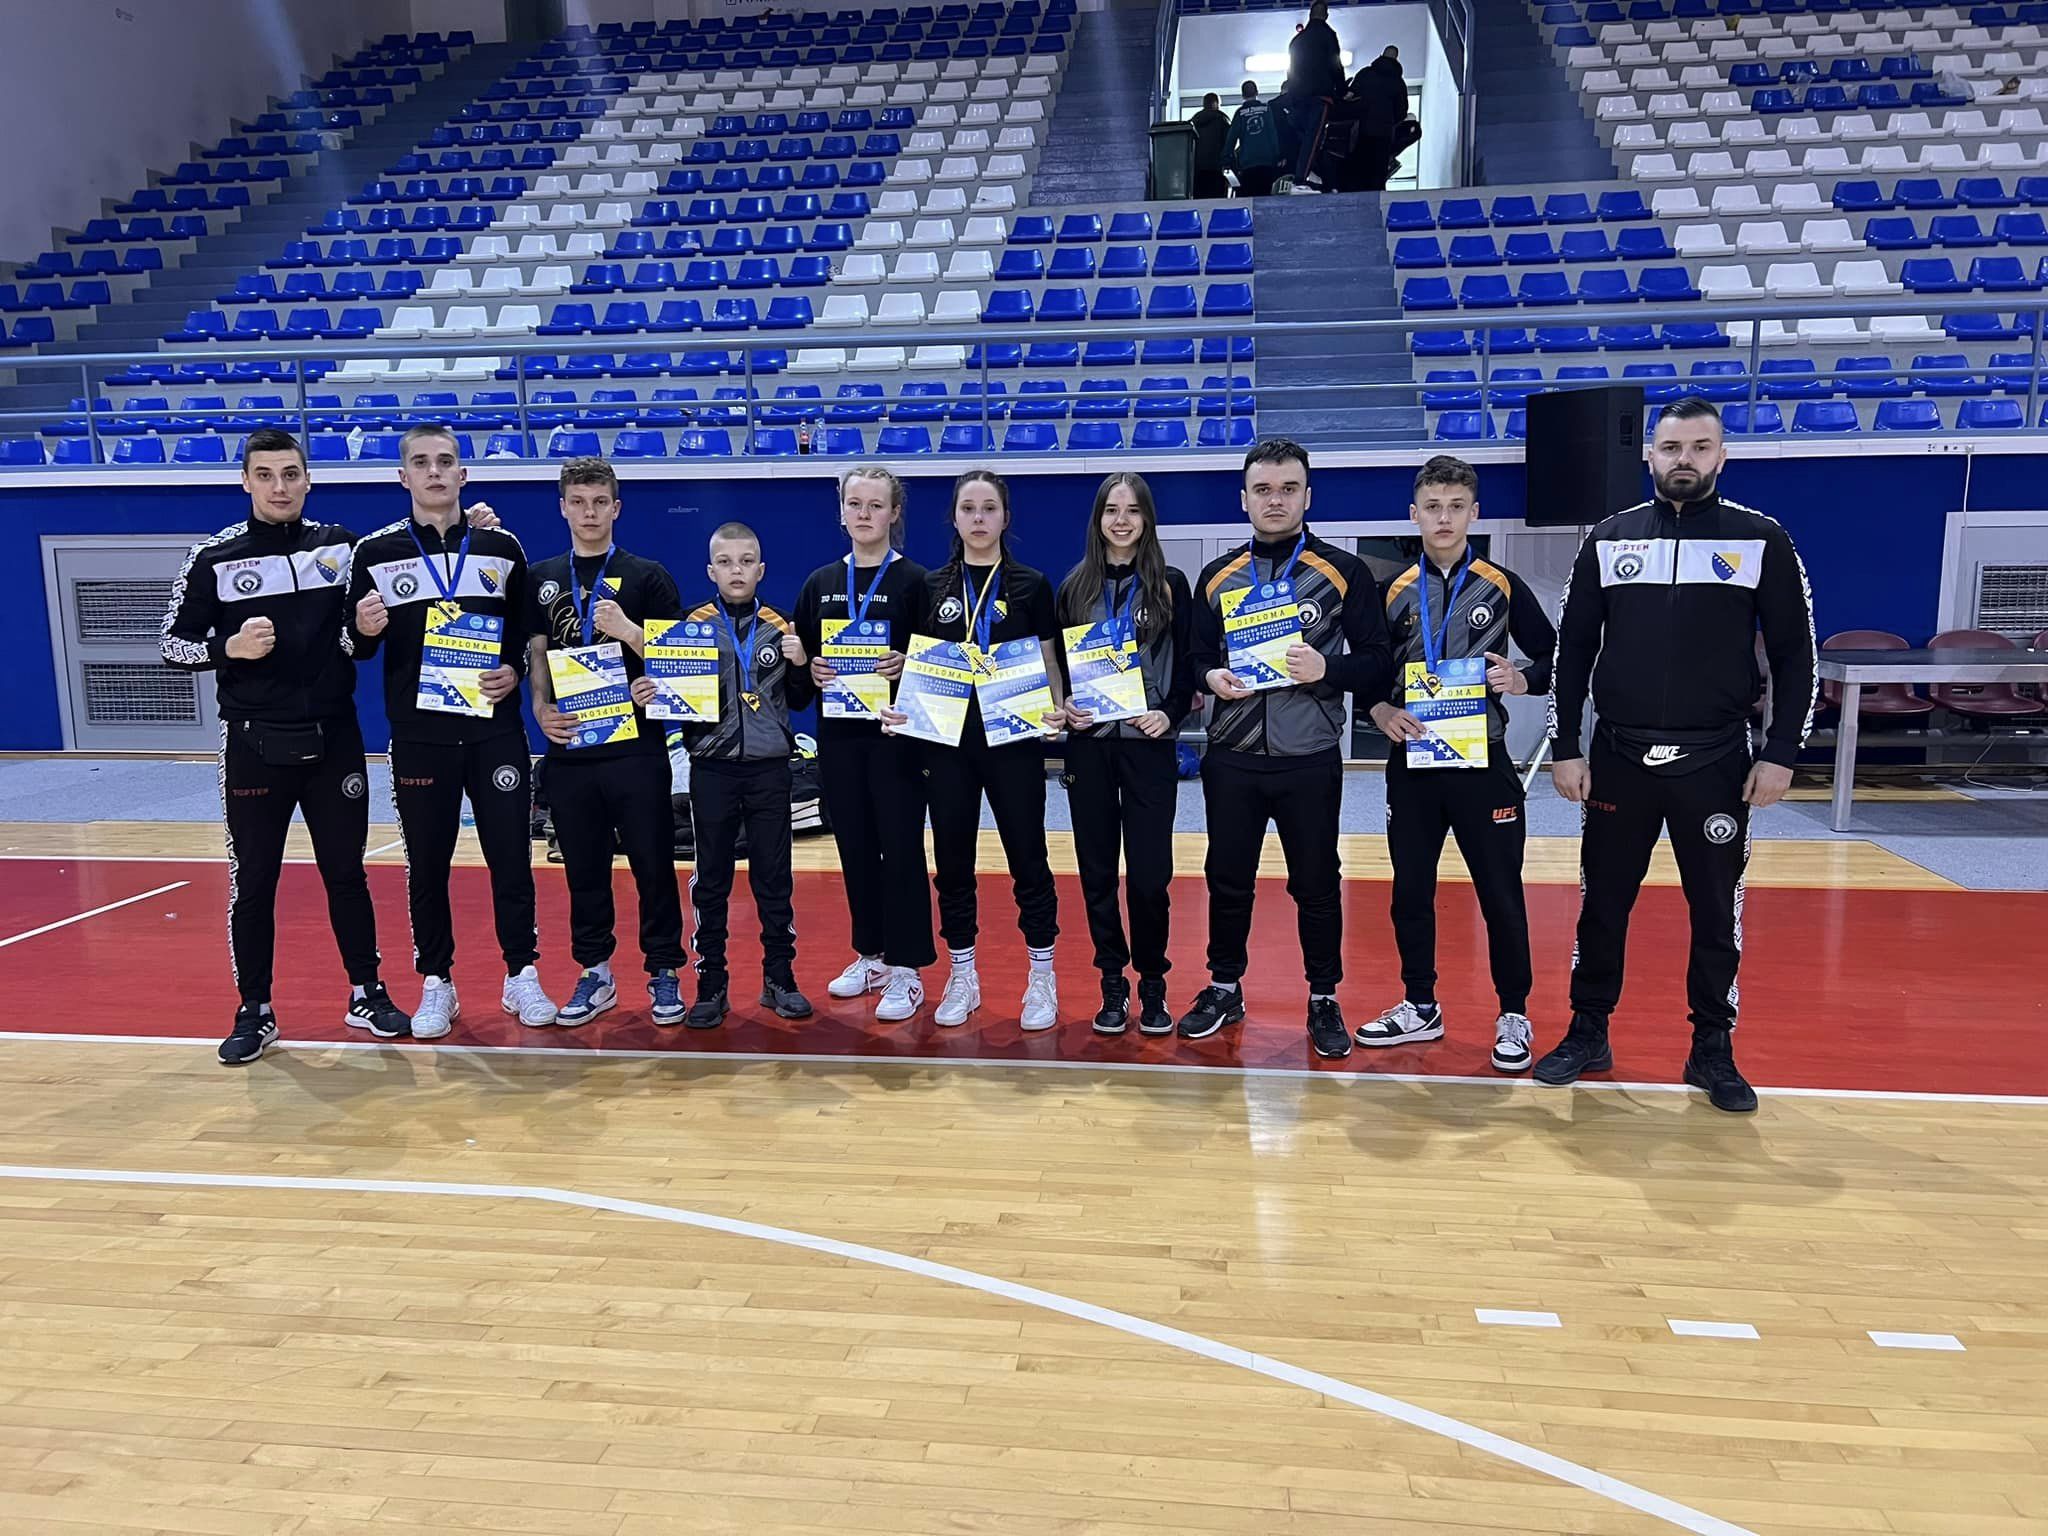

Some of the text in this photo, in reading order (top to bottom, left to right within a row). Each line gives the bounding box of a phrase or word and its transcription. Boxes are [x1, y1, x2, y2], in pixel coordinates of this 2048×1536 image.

[1237, 610, 1285, 626] DIPLOMA
[438, 638, 488, 651] DIPLOMA
[657, 649, 706, 657] DIPLOMA
[916, 664, 962, 679] DIPLOMA
[1419, 689, 1472, 698] DLOMA
[580, 706, 622, 720] DIPLOM
[1648, 745, 1680, 758] NIKE
[1493, 806, 1517, 818] UFC
